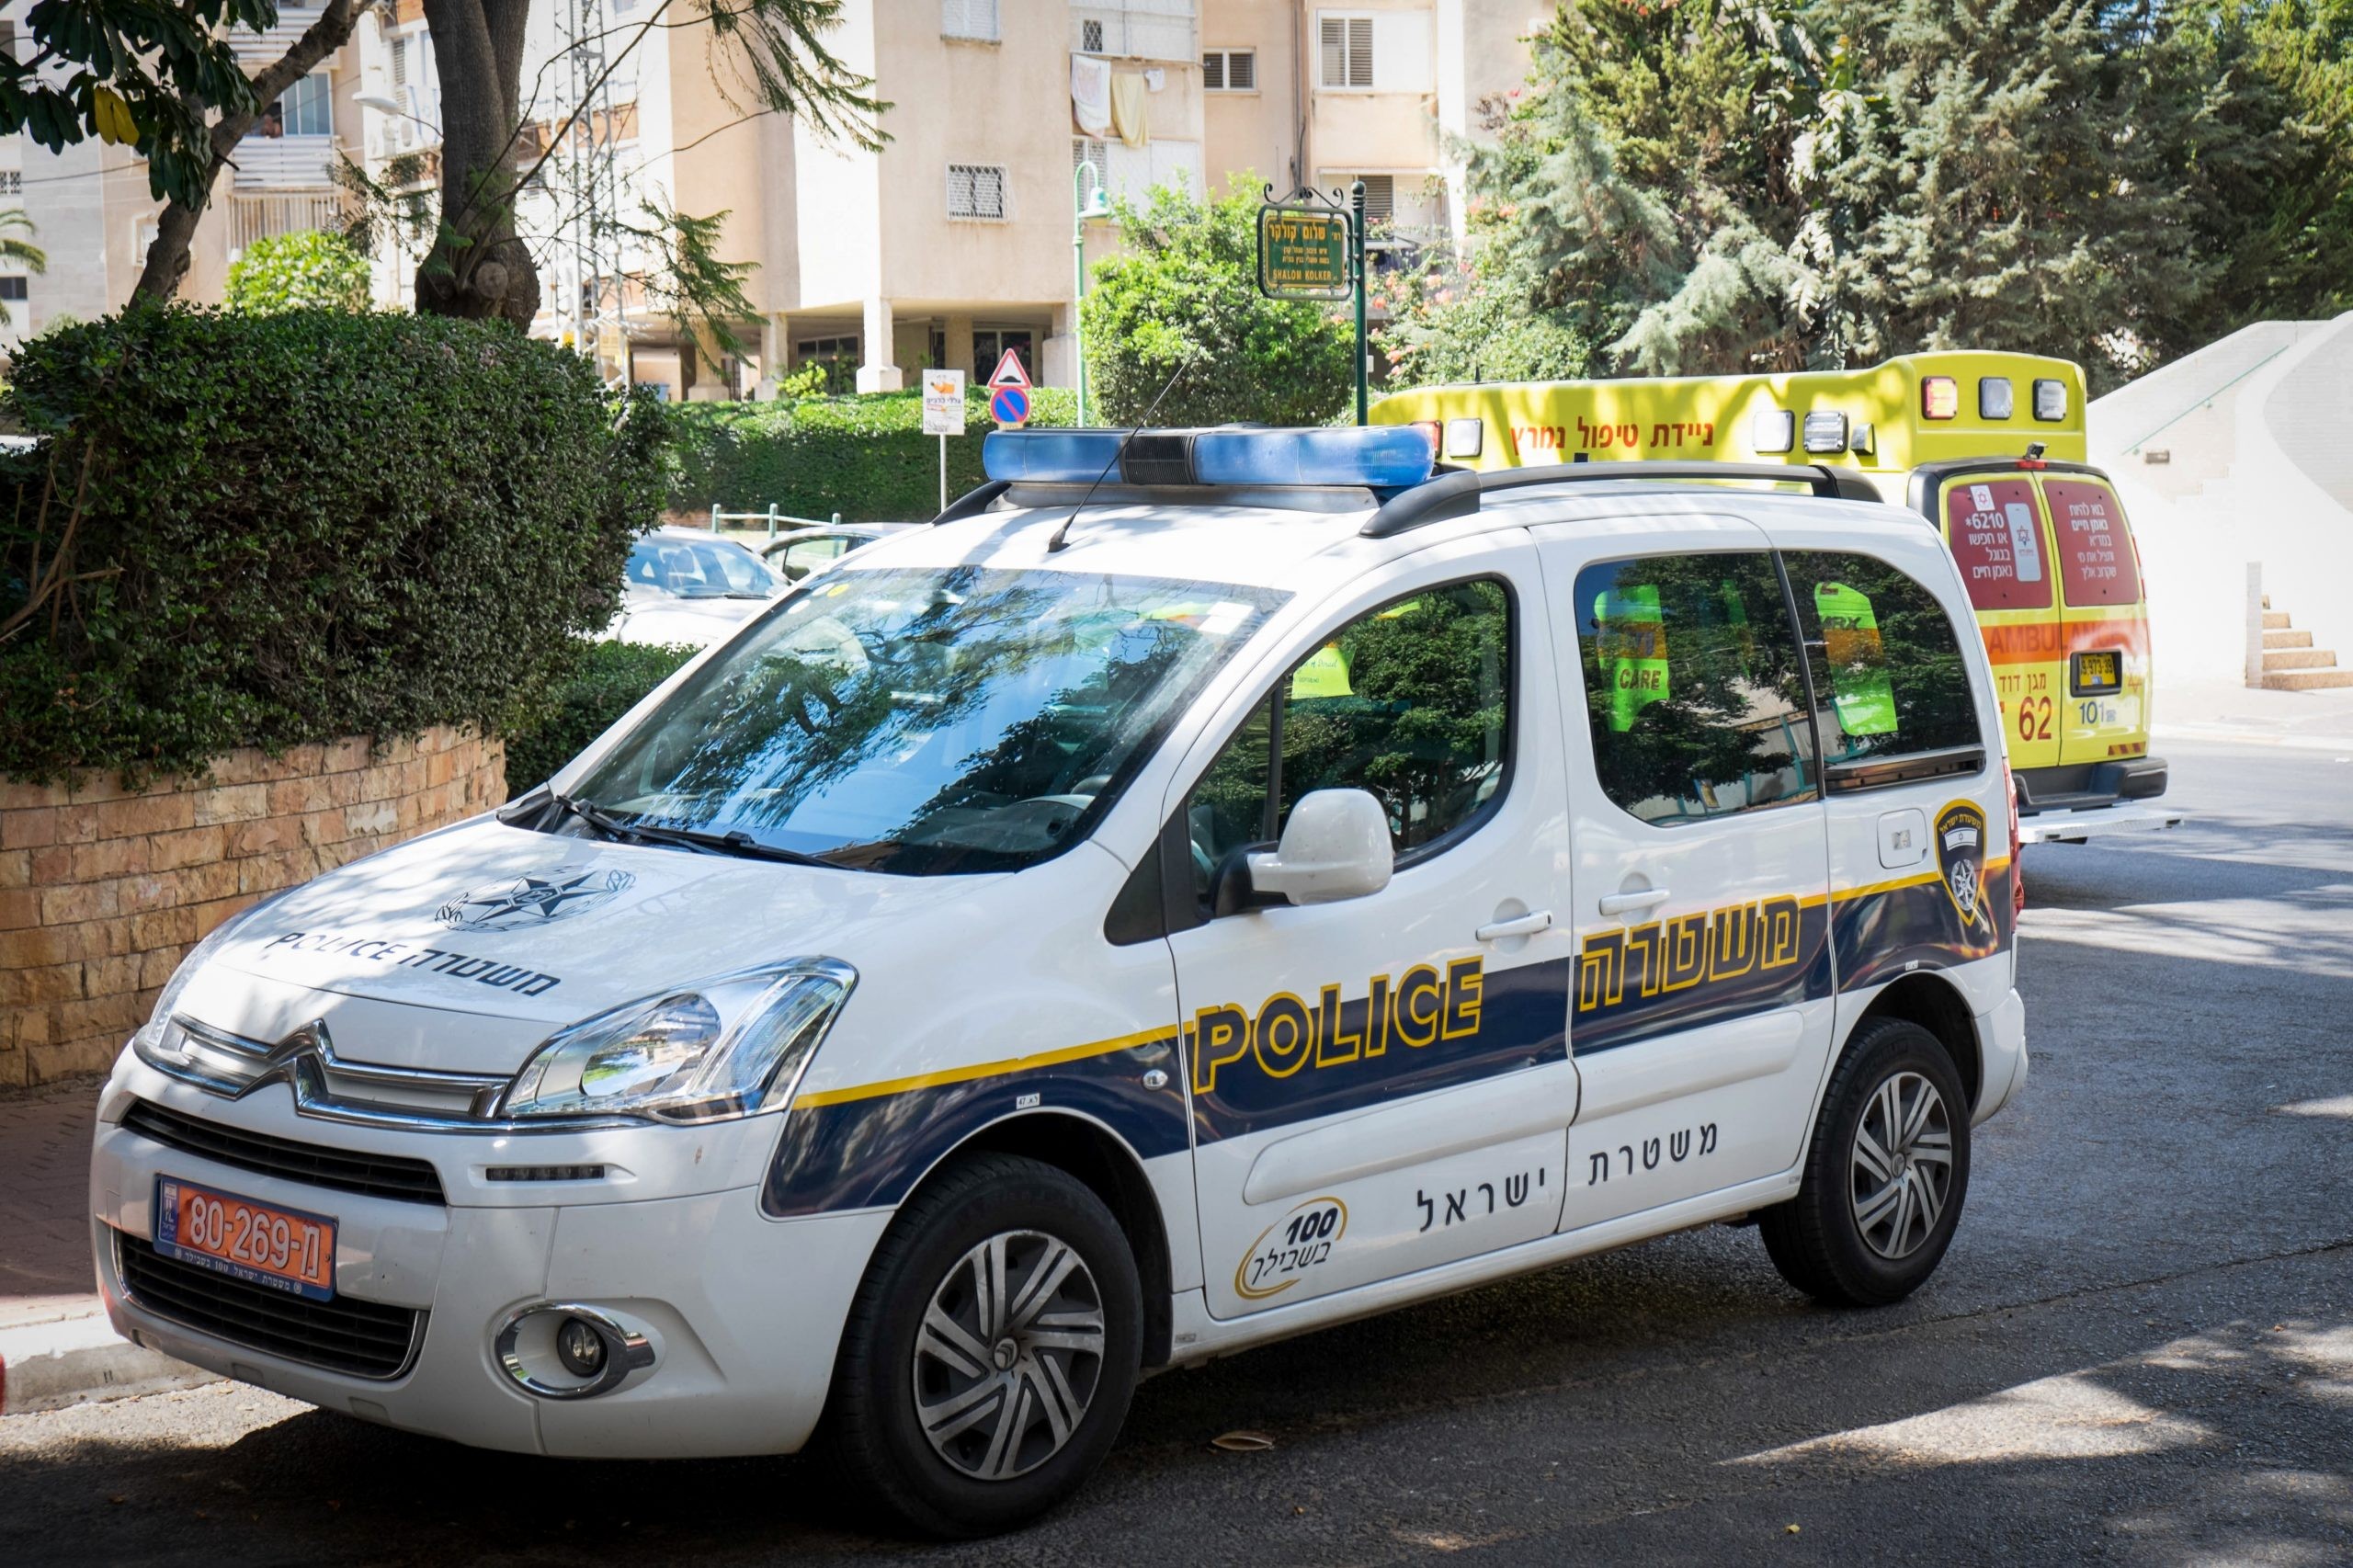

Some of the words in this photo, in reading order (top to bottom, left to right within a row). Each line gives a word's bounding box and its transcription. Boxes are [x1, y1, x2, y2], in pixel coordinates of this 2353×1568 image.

[1269, 221, 1297, 243] קולקר
[1303, 222, 1325, 240] שלום
[1273, 268, 1302, 280] SHALOM
[1305, 270, 1332, 281] KOLKER
[1510, 426, 1566, 456] נמרץ
[1577, 415, 1639, 449] טיפול
[1650, 423, 1714, 448] ניידת
[2071, 519, 2089, 531] חיים
[2089, 519, 2109, 534] נאמן
[1969, 533, 1995, 545] חפשו
[1997, 532, 2008, 545] או
[1985, 546, 2011, 562] בגוגל
[1972, 566, 1991, 579] חיים
[1992, 565, 2013, 581] נאמן
[1620, 668, 1661, 691] CARE
[1999, 674, 2020, 693] דוד
[2027, 673, 2046, 693] מגן
[2018, 696, 2052, 742] 62
[2079, 701, 2105, 724] 101
[1939, 814, 1959, 835] ישראל
[1959, 813, 1982, 830] משטרת
[265, 931, 408, 962] POLICE
[1579, 893, 1802, 1012] משטרה
[397, 948, 562, 997] משטרה
[1193, 955, 1483, 1096] POLICE
[1587, 1122, 1718, 1187] משטרת
[1416, 1167, 1546, 1233] ישראל
[1285, 1207, 1338, 1245] 100
[185, 1252, 211, 1267] בשבילך
[214, 1260, 229, 1273] 100
[1252, 1241, 1331, 1286] בשבילך
[233, 1265, 258, 1280] ישראל
[262, 1276, 290, 1290] משטרת
